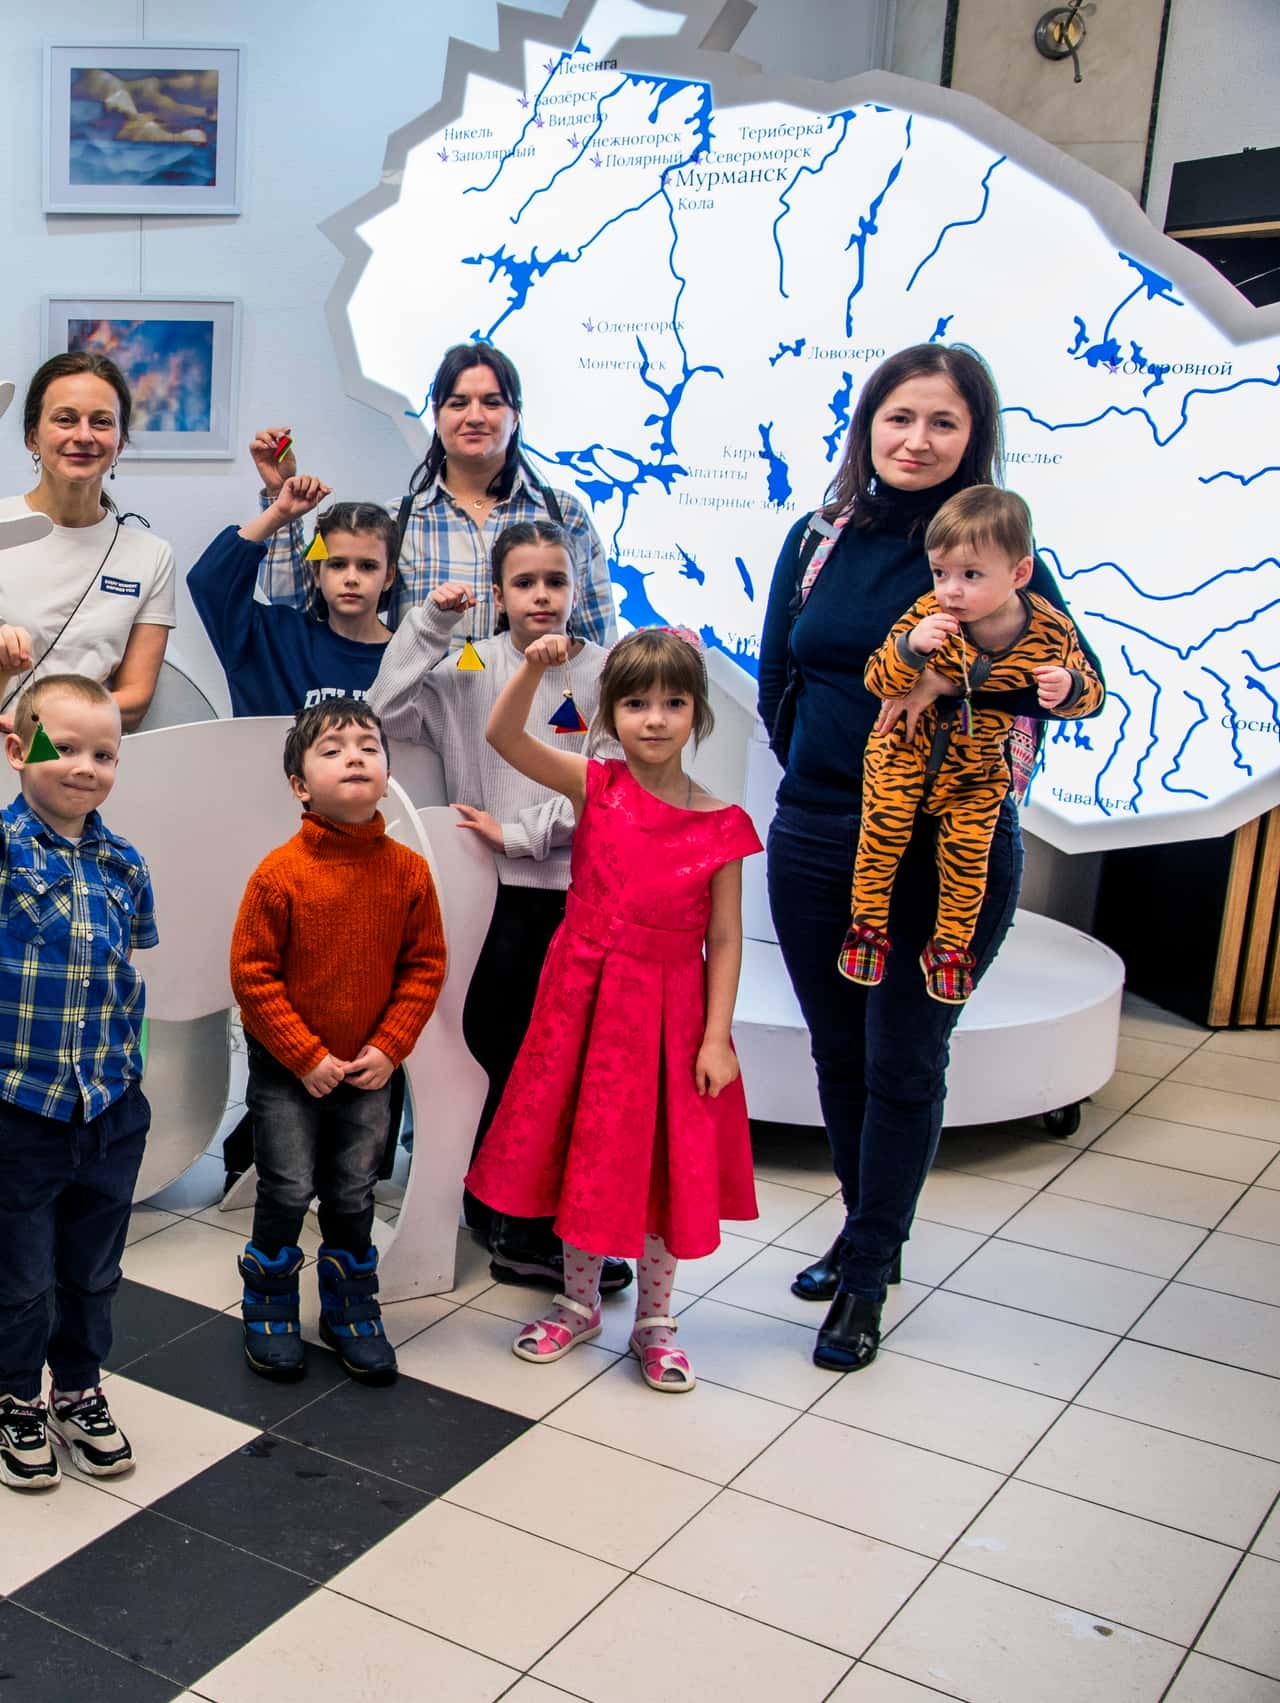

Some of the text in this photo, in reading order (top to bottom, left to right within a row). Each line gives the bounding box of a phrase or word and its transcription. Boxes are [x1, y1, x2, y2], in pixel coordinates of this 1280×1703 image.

[560, 59, 617, 75] Печенга
[444, 128, 493, 141] Никель
[582, 132, 681, 149] Снежногорск
[738, 122, 823, 143] Териберка
[606, 151, 684, 169] Полярный
[706, 146, 812, 166] Североморск
[676, 166, 789, 192] Мурманск
[678, 197, 714, 211] Кола
[597, 319, 686, 336] Оленегорск
[808, 346, 886, 363] Ловозеро
[578, 357, 666, 371] Мончегоск
[723, 446, 787, 462] Кирок
[679, 492, 756, 511] Полярные
